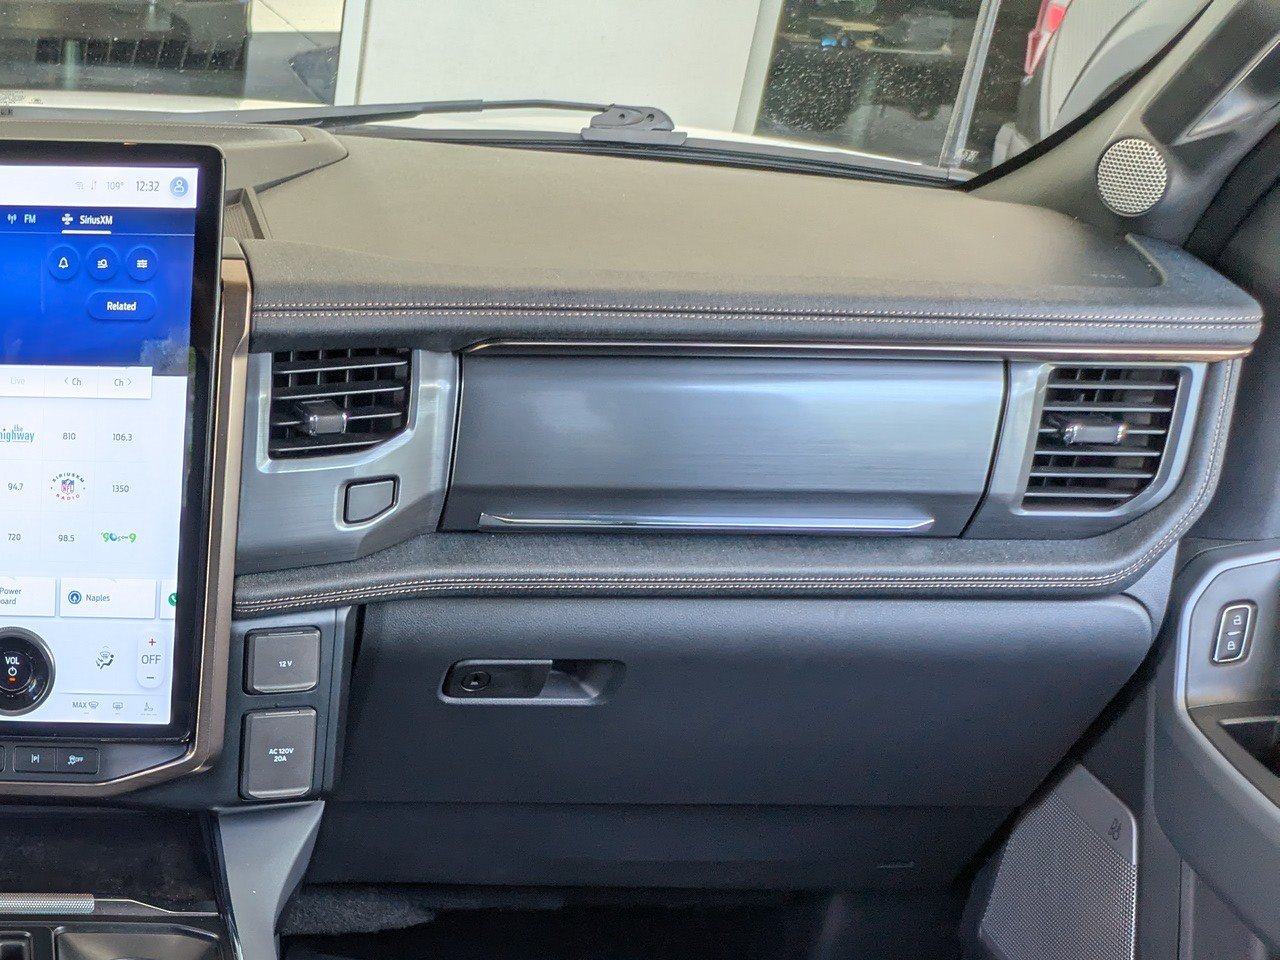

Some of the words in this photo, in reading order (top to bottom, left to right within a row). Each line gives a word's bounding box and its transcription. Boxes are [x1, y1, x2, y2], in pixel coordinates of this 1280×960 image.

[136, 181, 160, 192] 12:32
[24, 214, 36, 223] FM
[80, 215, 113, 225] SiriusXM
[106, 301, 137, 311] Related
[62, 432, 76, 440] 810
[112, 433, 133, 441] 106.3
[7, 482, 24, 490] 94.7
[112, 484, 130, 493] 1350
[7, 533, 22, 541] 720
[58, 534, 75, 542] 98.5
[0, 587, 22, 596] Power
[85, 594, 111, 602] Naples
[4, 656, 20, 665] VOL
[141, 654, 162, 665] OFF
[72, 701, 87, 709] MAX
[278, 747, 294, 755] 120V
